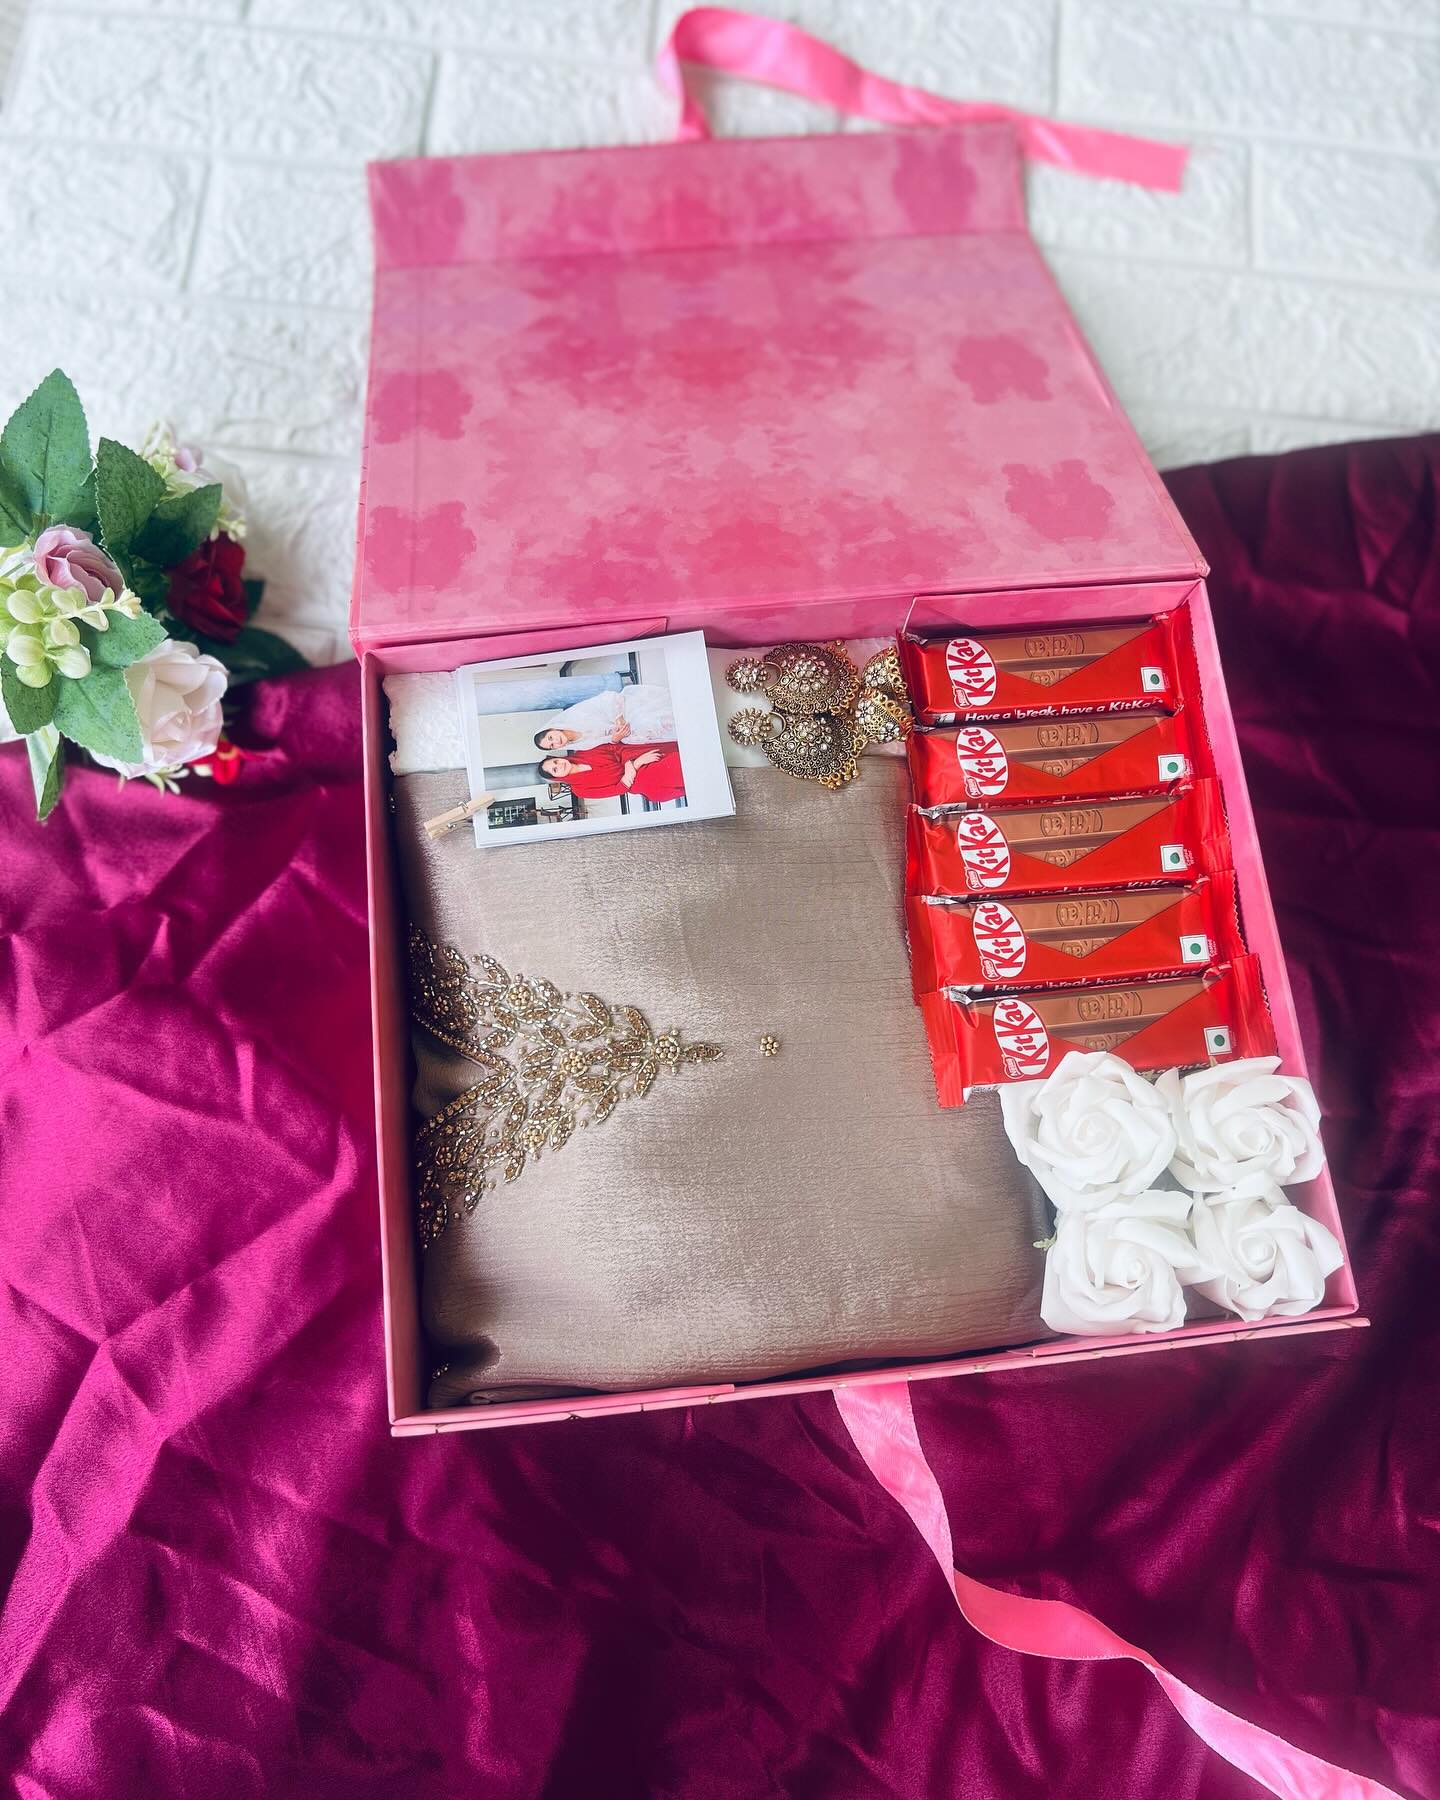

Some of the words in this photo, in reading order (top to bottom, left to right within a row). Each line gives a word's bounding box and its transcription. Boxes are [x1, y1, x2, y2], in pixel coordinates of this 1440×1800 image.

[947, 640, 995, 698] KitKat
[965, 712, 1000, 721] Have
[1061, 705, 1093, 715] have
[958, 729, 1007, 787] KitKat
[959, 816, 1008, 879] KitKat
[974, 904, 1024, 969] KitKat
[994, 1002, 1048, 1068] KitKat
